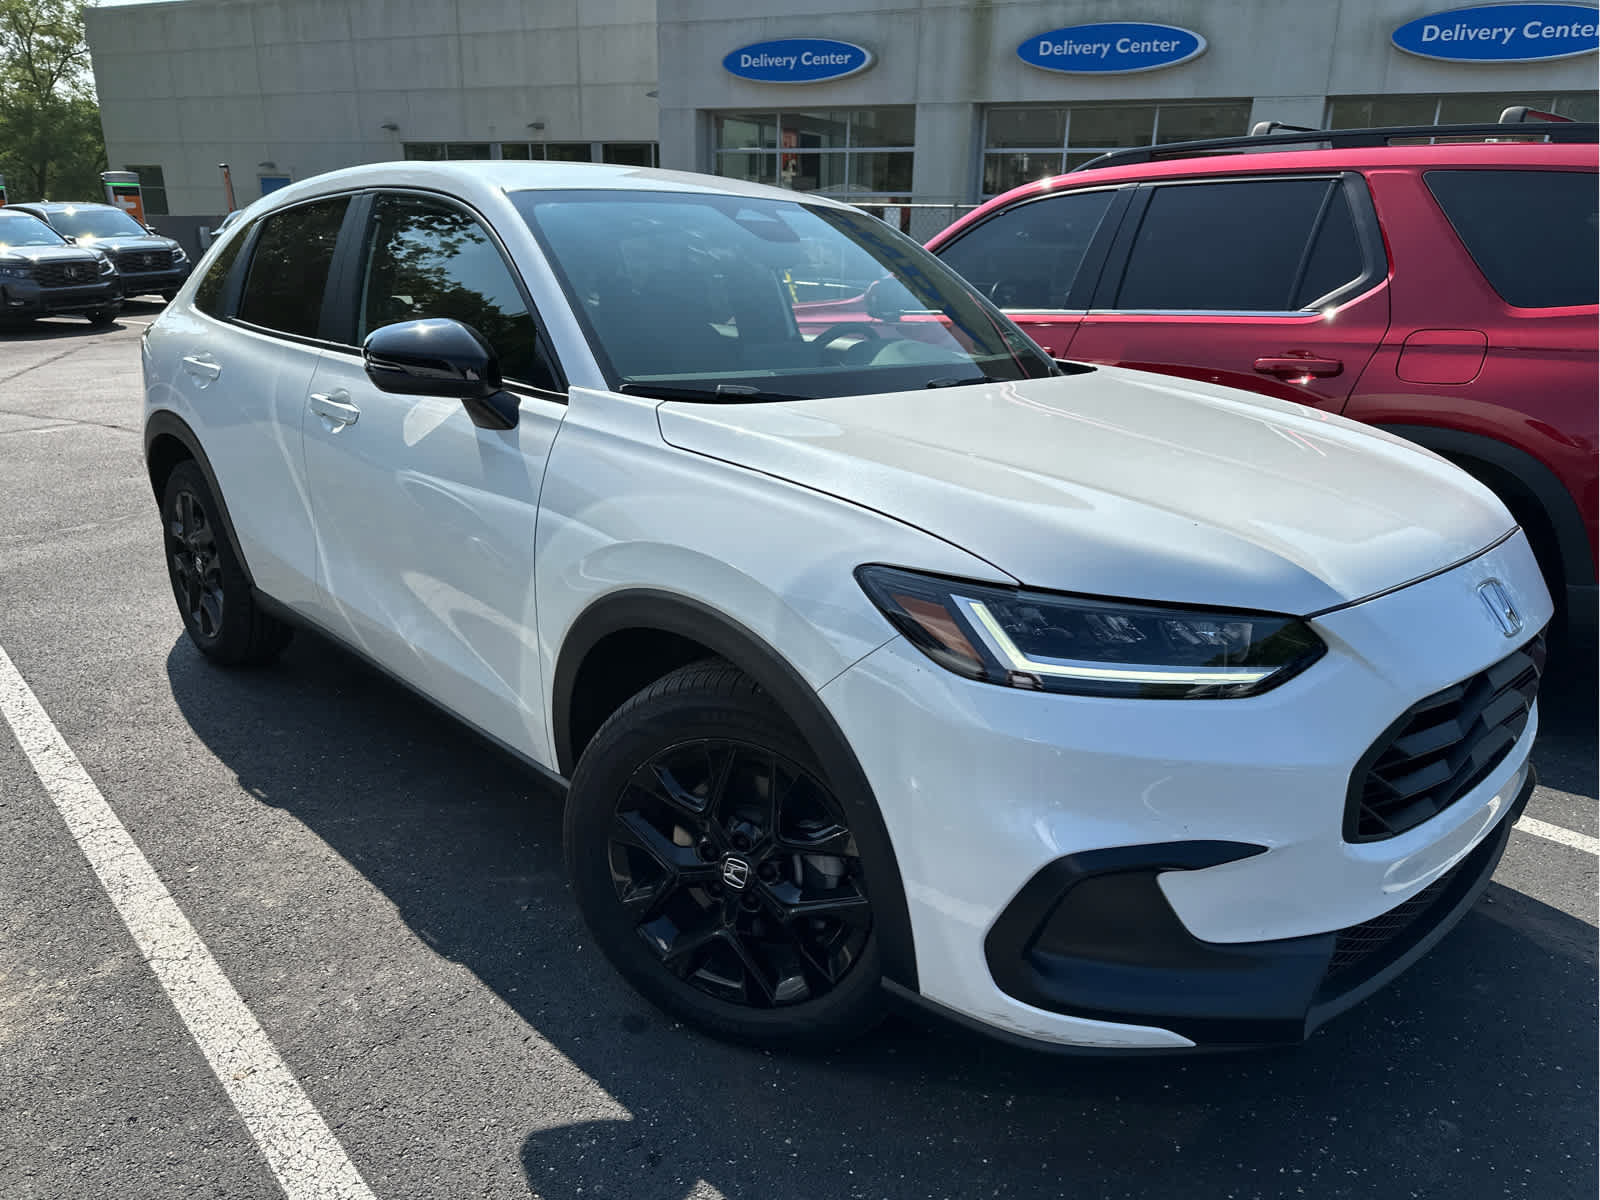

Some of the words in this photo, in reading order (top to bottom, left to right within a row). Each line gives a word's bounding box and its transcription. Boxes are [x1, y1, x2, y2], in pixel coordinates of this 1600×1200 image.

[1422, 23, 1516, 45] Delivery
[1040, 40, 1111, 58] Delivery
[1117, 39, 1180, 54] Center
[742, 55, 796, 70] Delivery
[801, 51, 851, 66] Center
